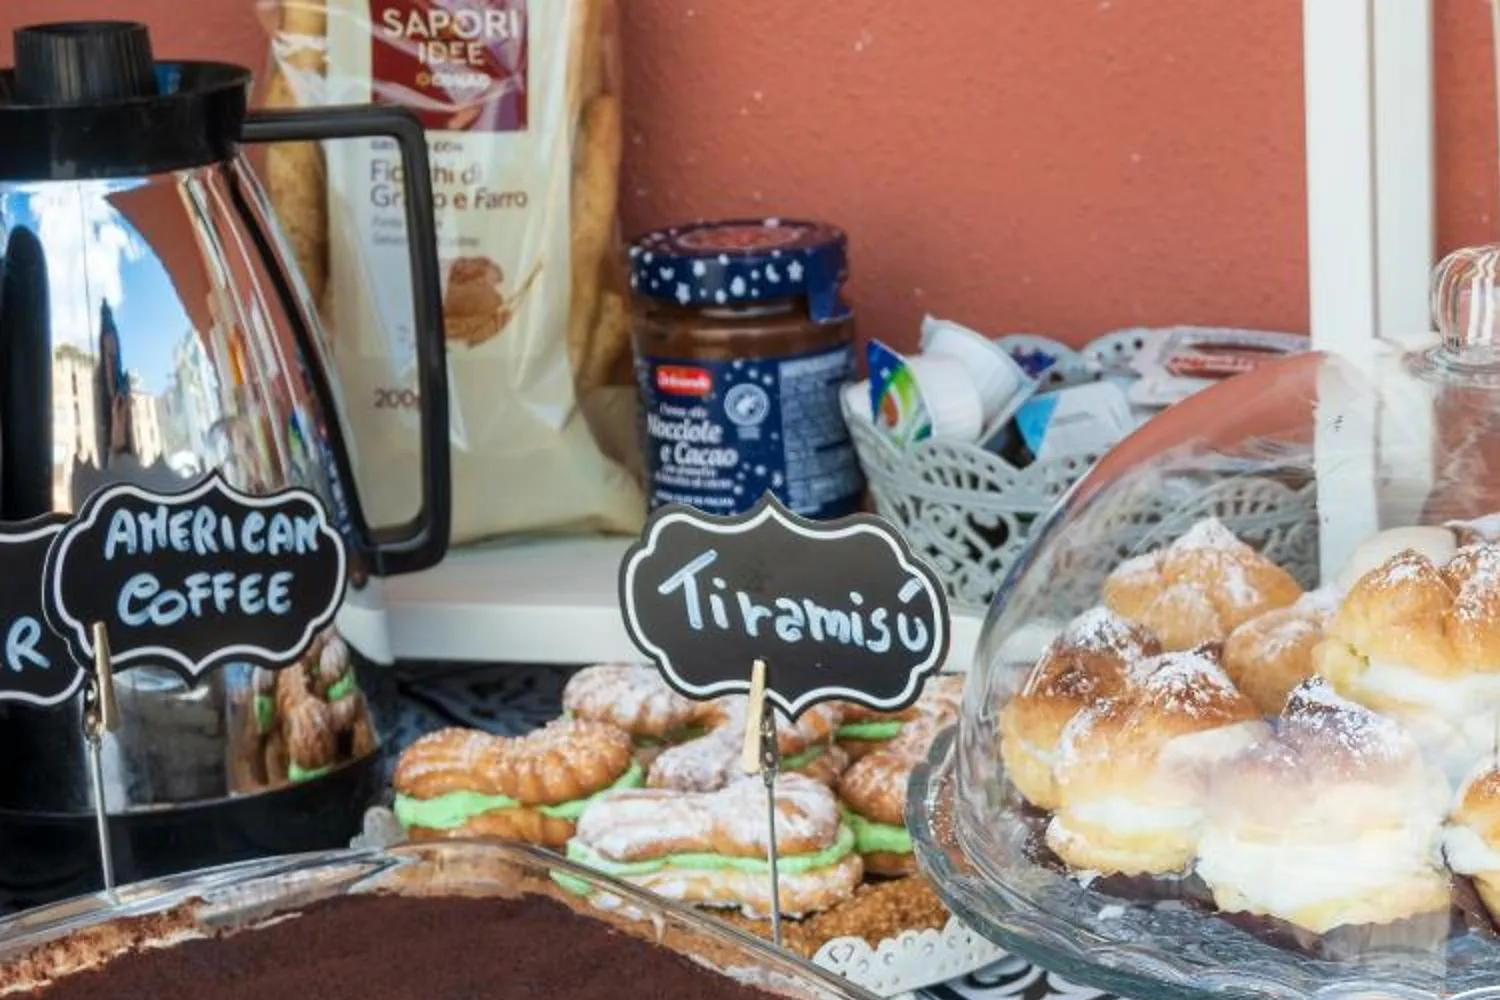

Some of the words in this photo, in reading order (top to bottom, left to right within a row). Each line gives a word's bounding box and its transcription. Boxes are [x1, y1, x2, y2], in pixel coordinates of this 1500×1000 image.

[383, 8, 519, 40] SAPORI
[417, 41, 484, 65] IDEE
[370, 158, 455, 183] Fiohi
[370, 184, 447, 209] Gro
[674, 441, 739, 467] Cacao
[105, 505, 323, 560] AMERICAN
[117, 571, 295, 626] COFFEE
